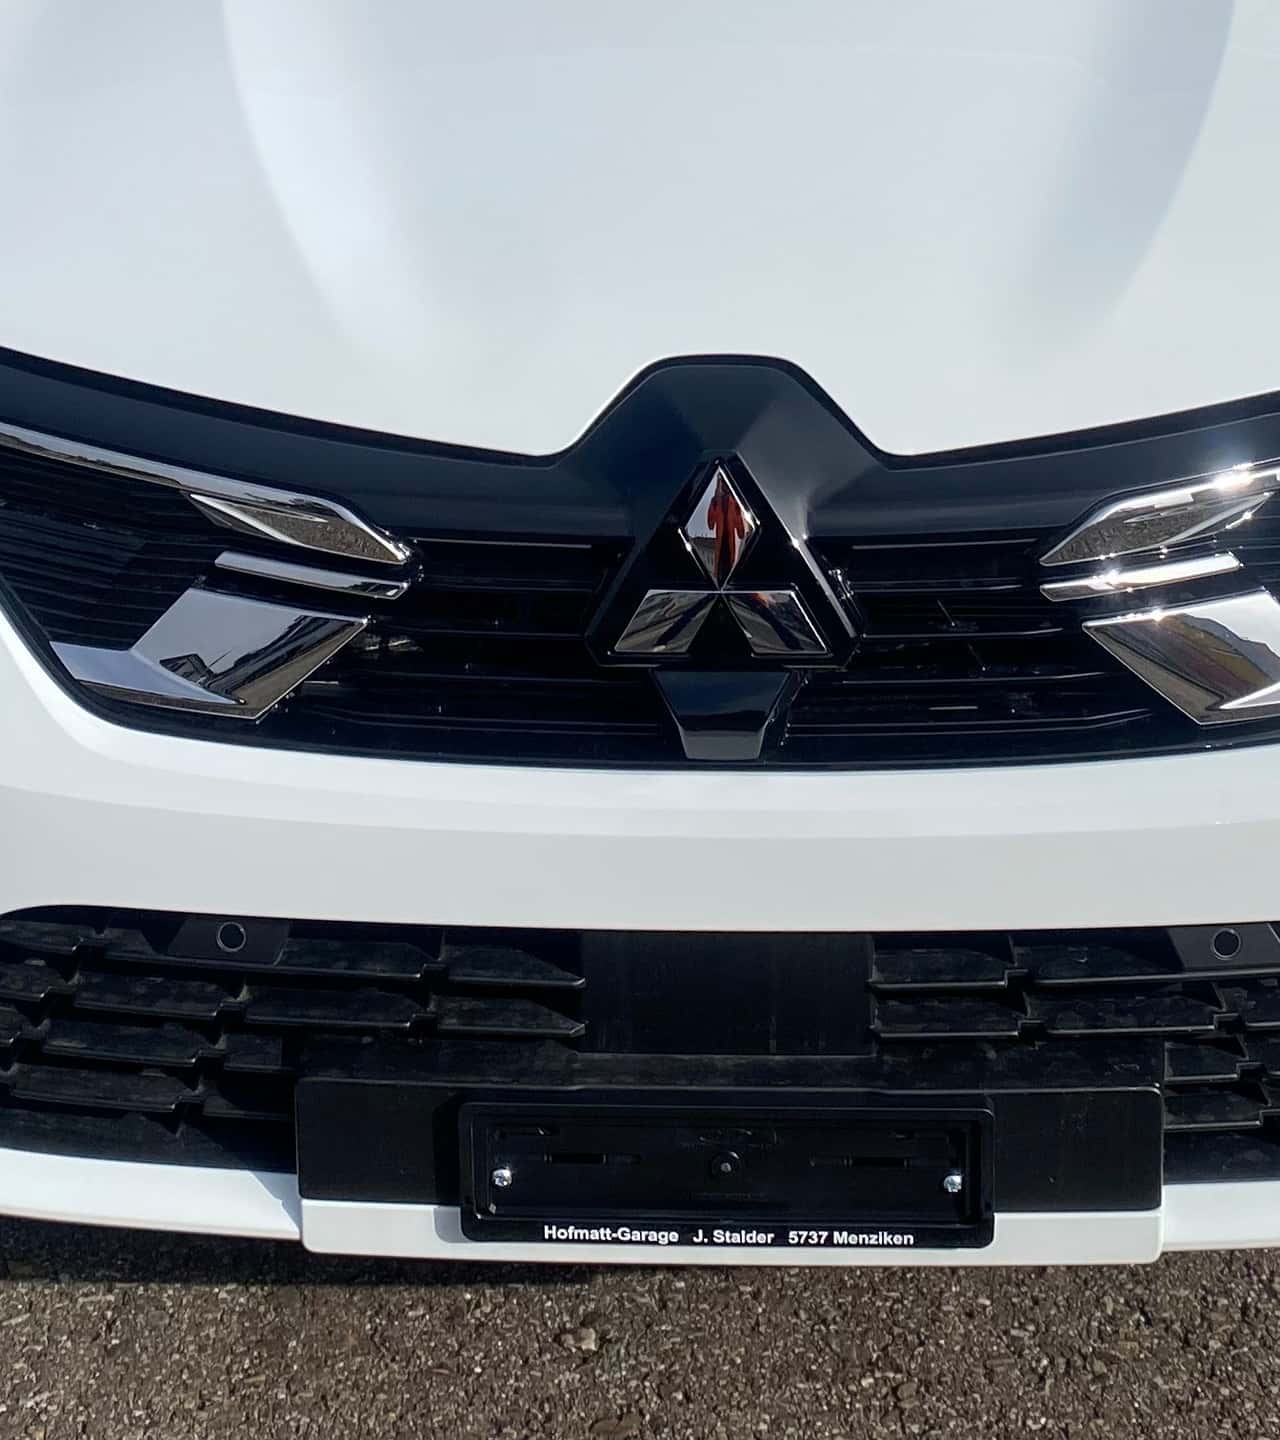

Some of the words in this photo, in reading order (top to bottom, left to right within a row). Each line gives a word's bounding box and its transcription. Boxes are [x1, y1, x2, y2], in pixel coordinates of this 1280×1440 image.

[543, 1225, 679, 1245] Hofmatt-Garage
[692, 1229, 709, 1244] J.
[712, 1229, 775, 1245] Stalder
[788, 1230, 828, 1245] 5737
[833, 1231, 915, 1246] Menziken
